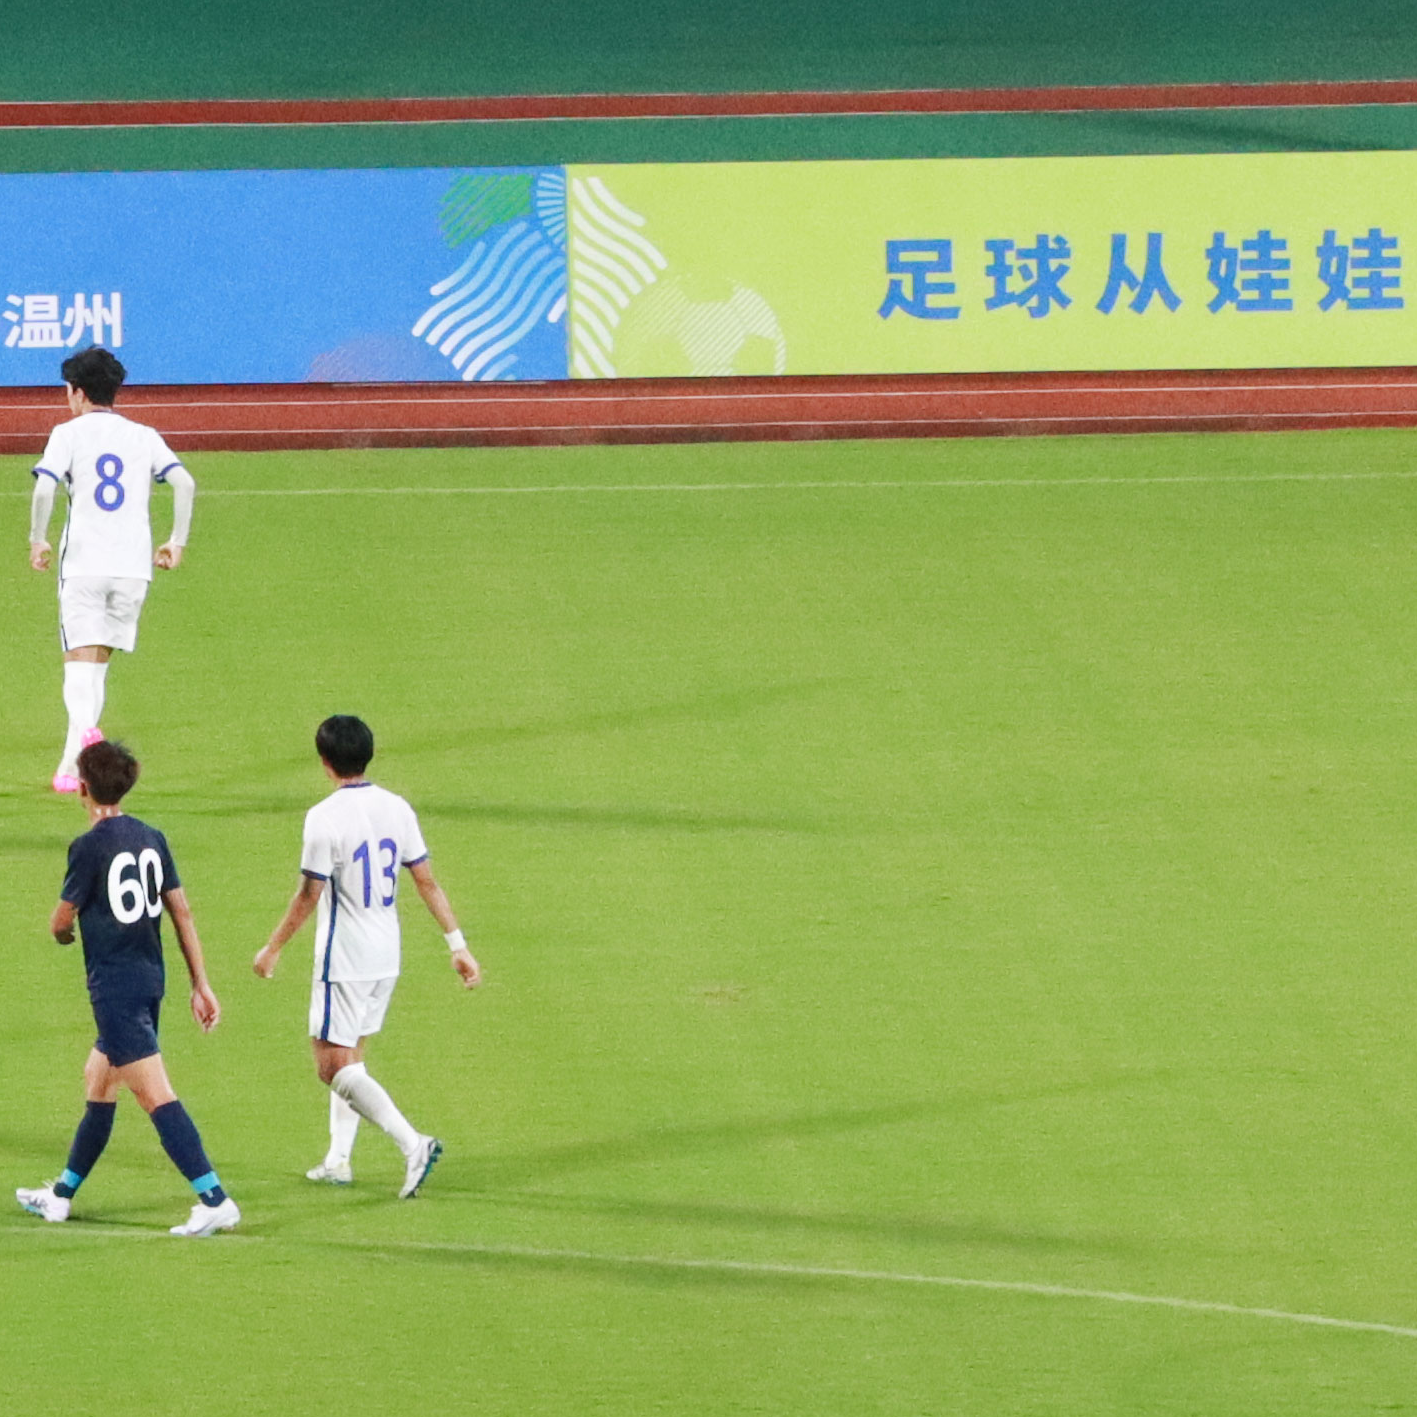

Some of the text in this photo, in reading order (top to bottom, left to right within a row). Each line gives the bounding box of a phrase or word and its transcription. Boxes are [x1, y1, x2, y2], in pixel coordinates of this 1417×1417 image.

[878, 229, 1404, 320] 足球从娃娃
[94, 453, 124, 512] 8
[107, 847, 164, 924] 60
[352, 837, 398, 909] 13
